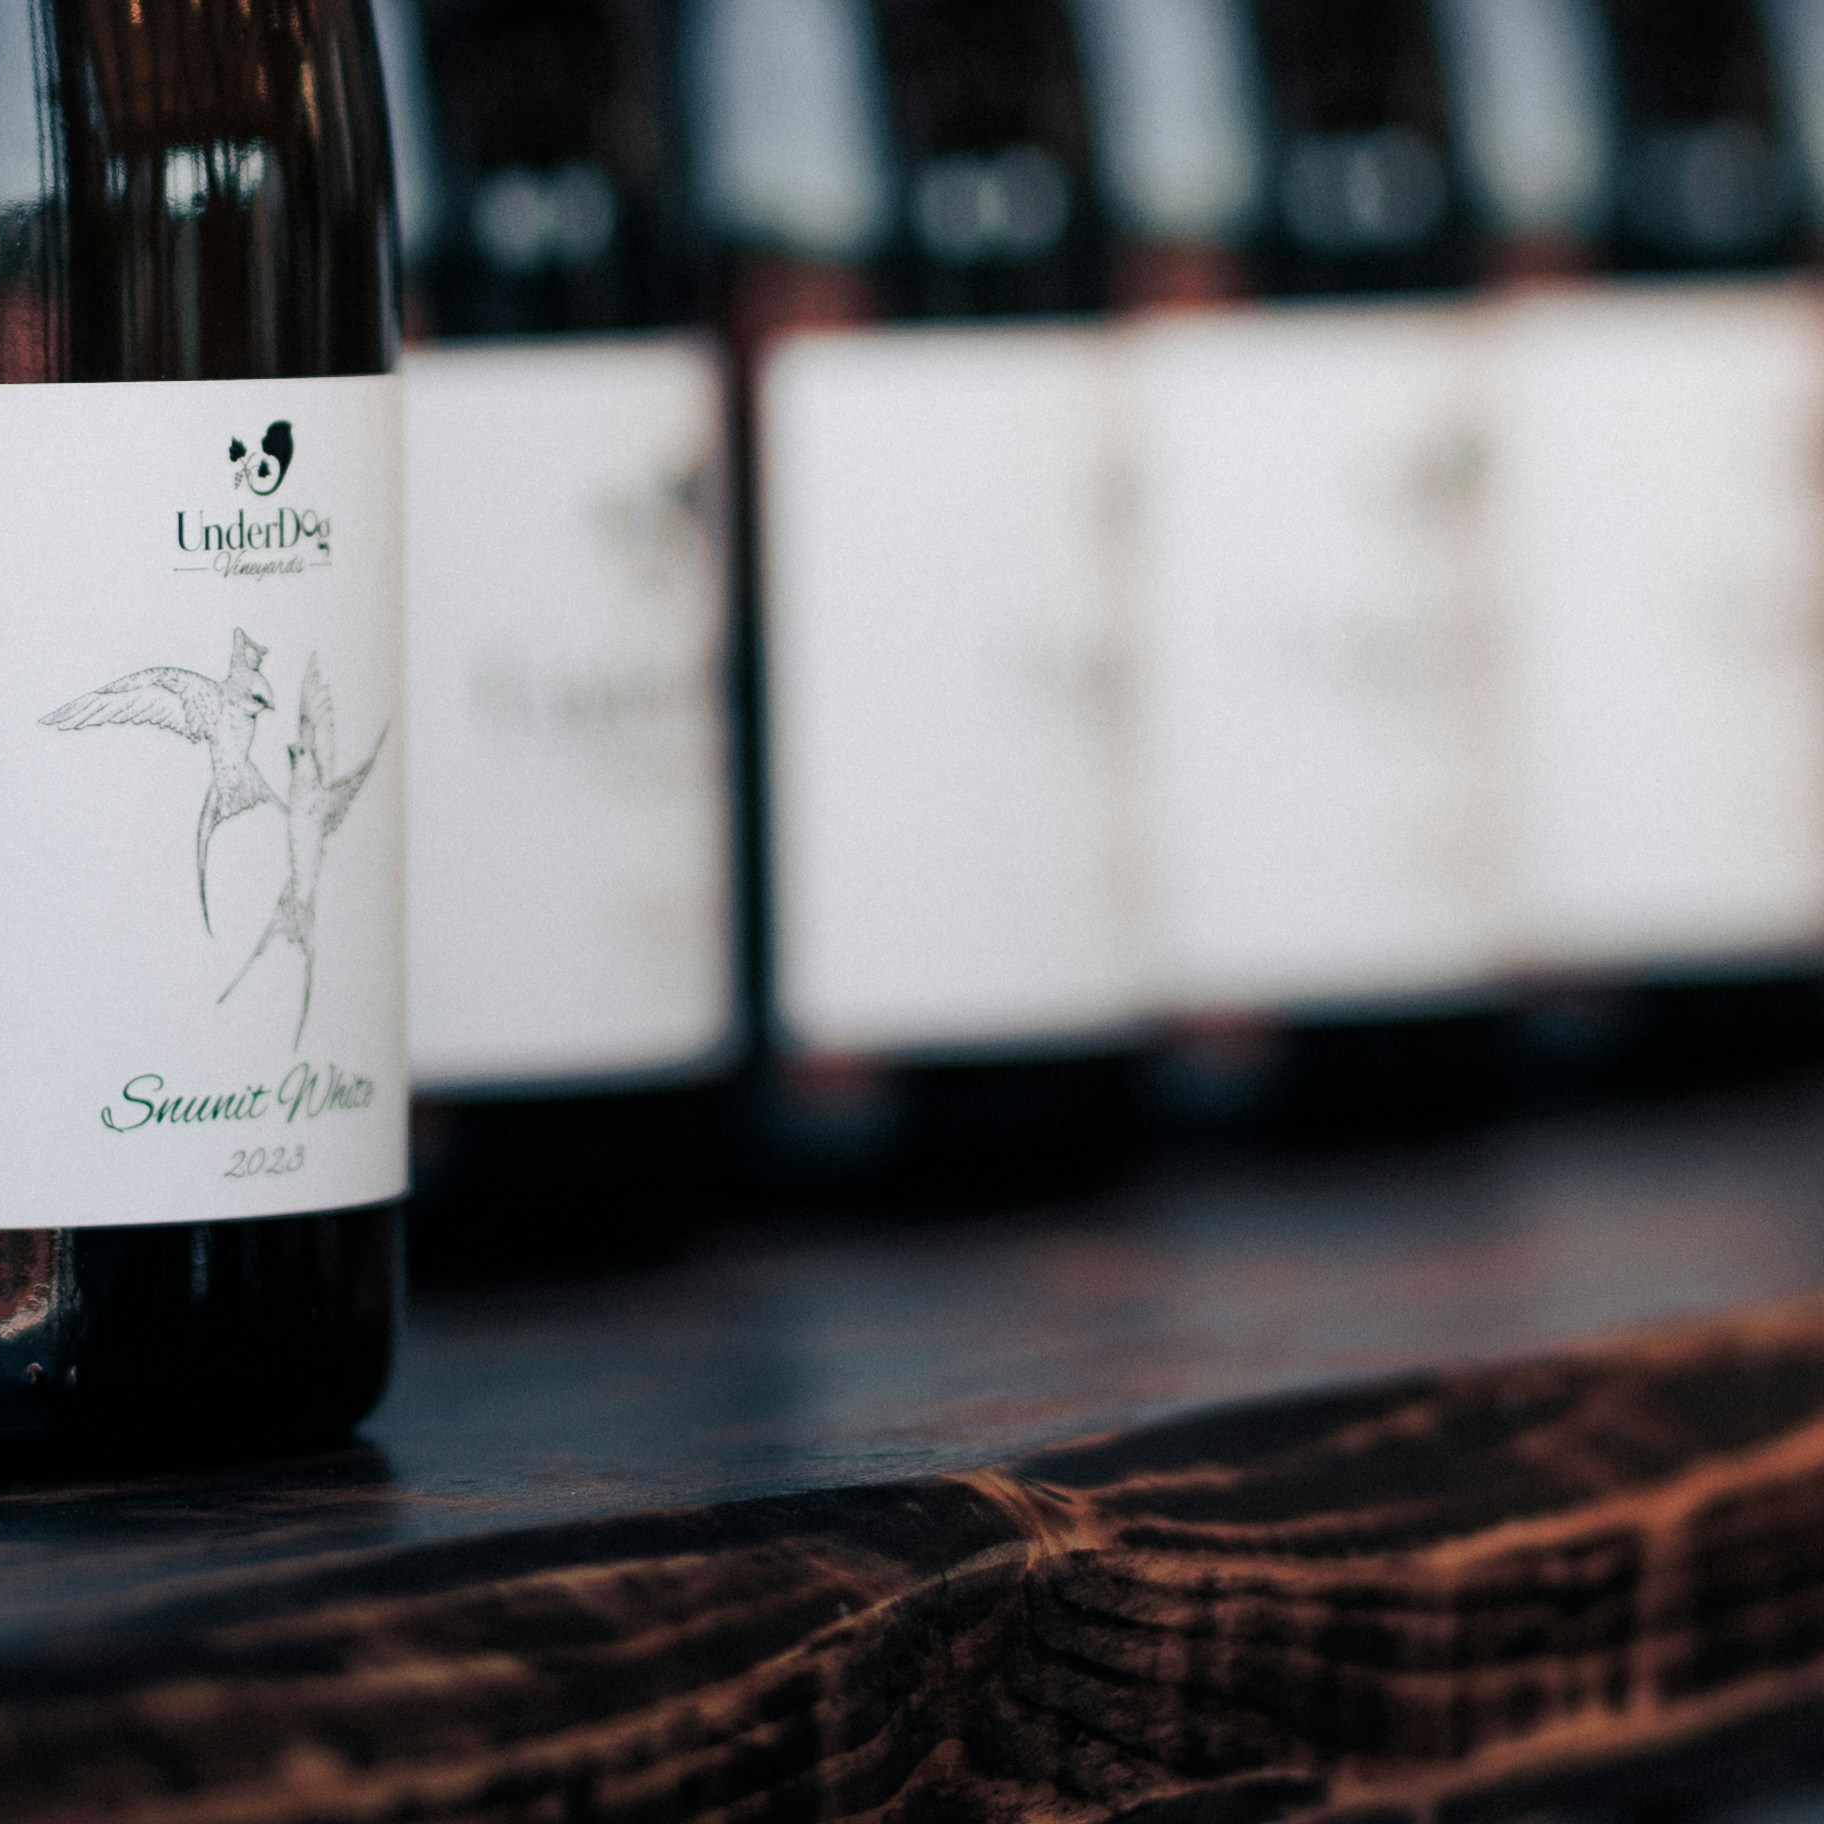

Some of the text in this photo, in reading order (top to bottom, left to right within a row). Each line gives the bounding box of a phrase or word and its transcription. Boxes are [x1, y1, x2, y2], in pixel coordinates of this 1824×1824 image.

[176, 507, 331, 557] UnderDog
[213, 550, 306, 582] Vineyards
[101, 1073, 272, 1133] Snunit
[224, 1144, 306, 1178] 2023
